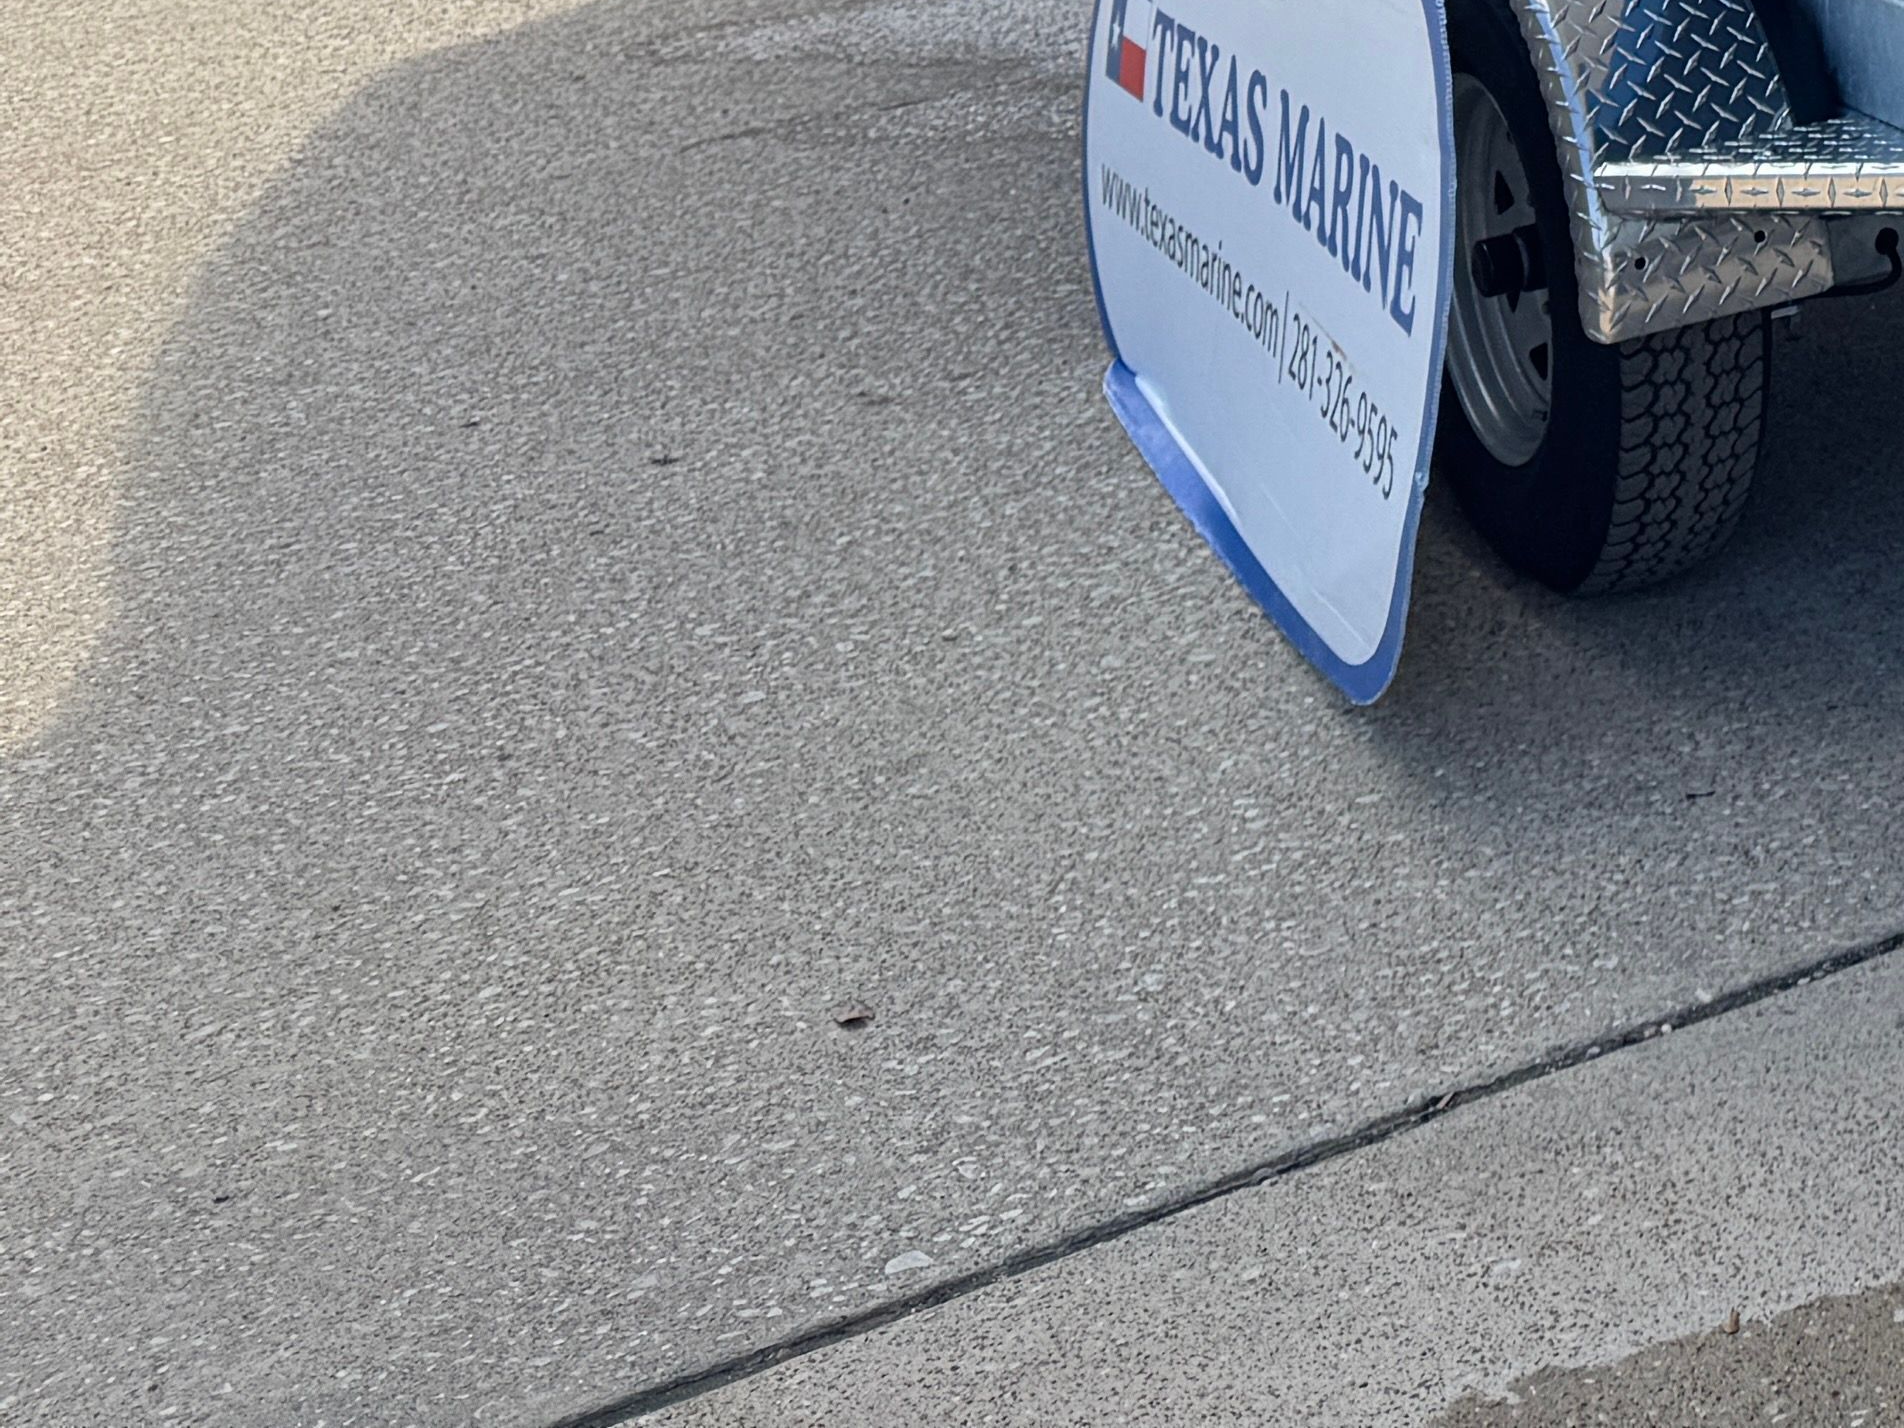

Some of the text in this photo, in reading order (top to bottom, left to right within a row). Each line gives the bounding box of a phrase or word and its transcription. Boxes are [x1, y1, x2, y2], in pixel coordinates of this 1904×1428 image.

[1101, 163, 1279, 358] www.texasmarine.com
[1288, 312, 1398, 501] 281-326-9595
[1152, 8, 1423, 338] TEXAS MARINE
